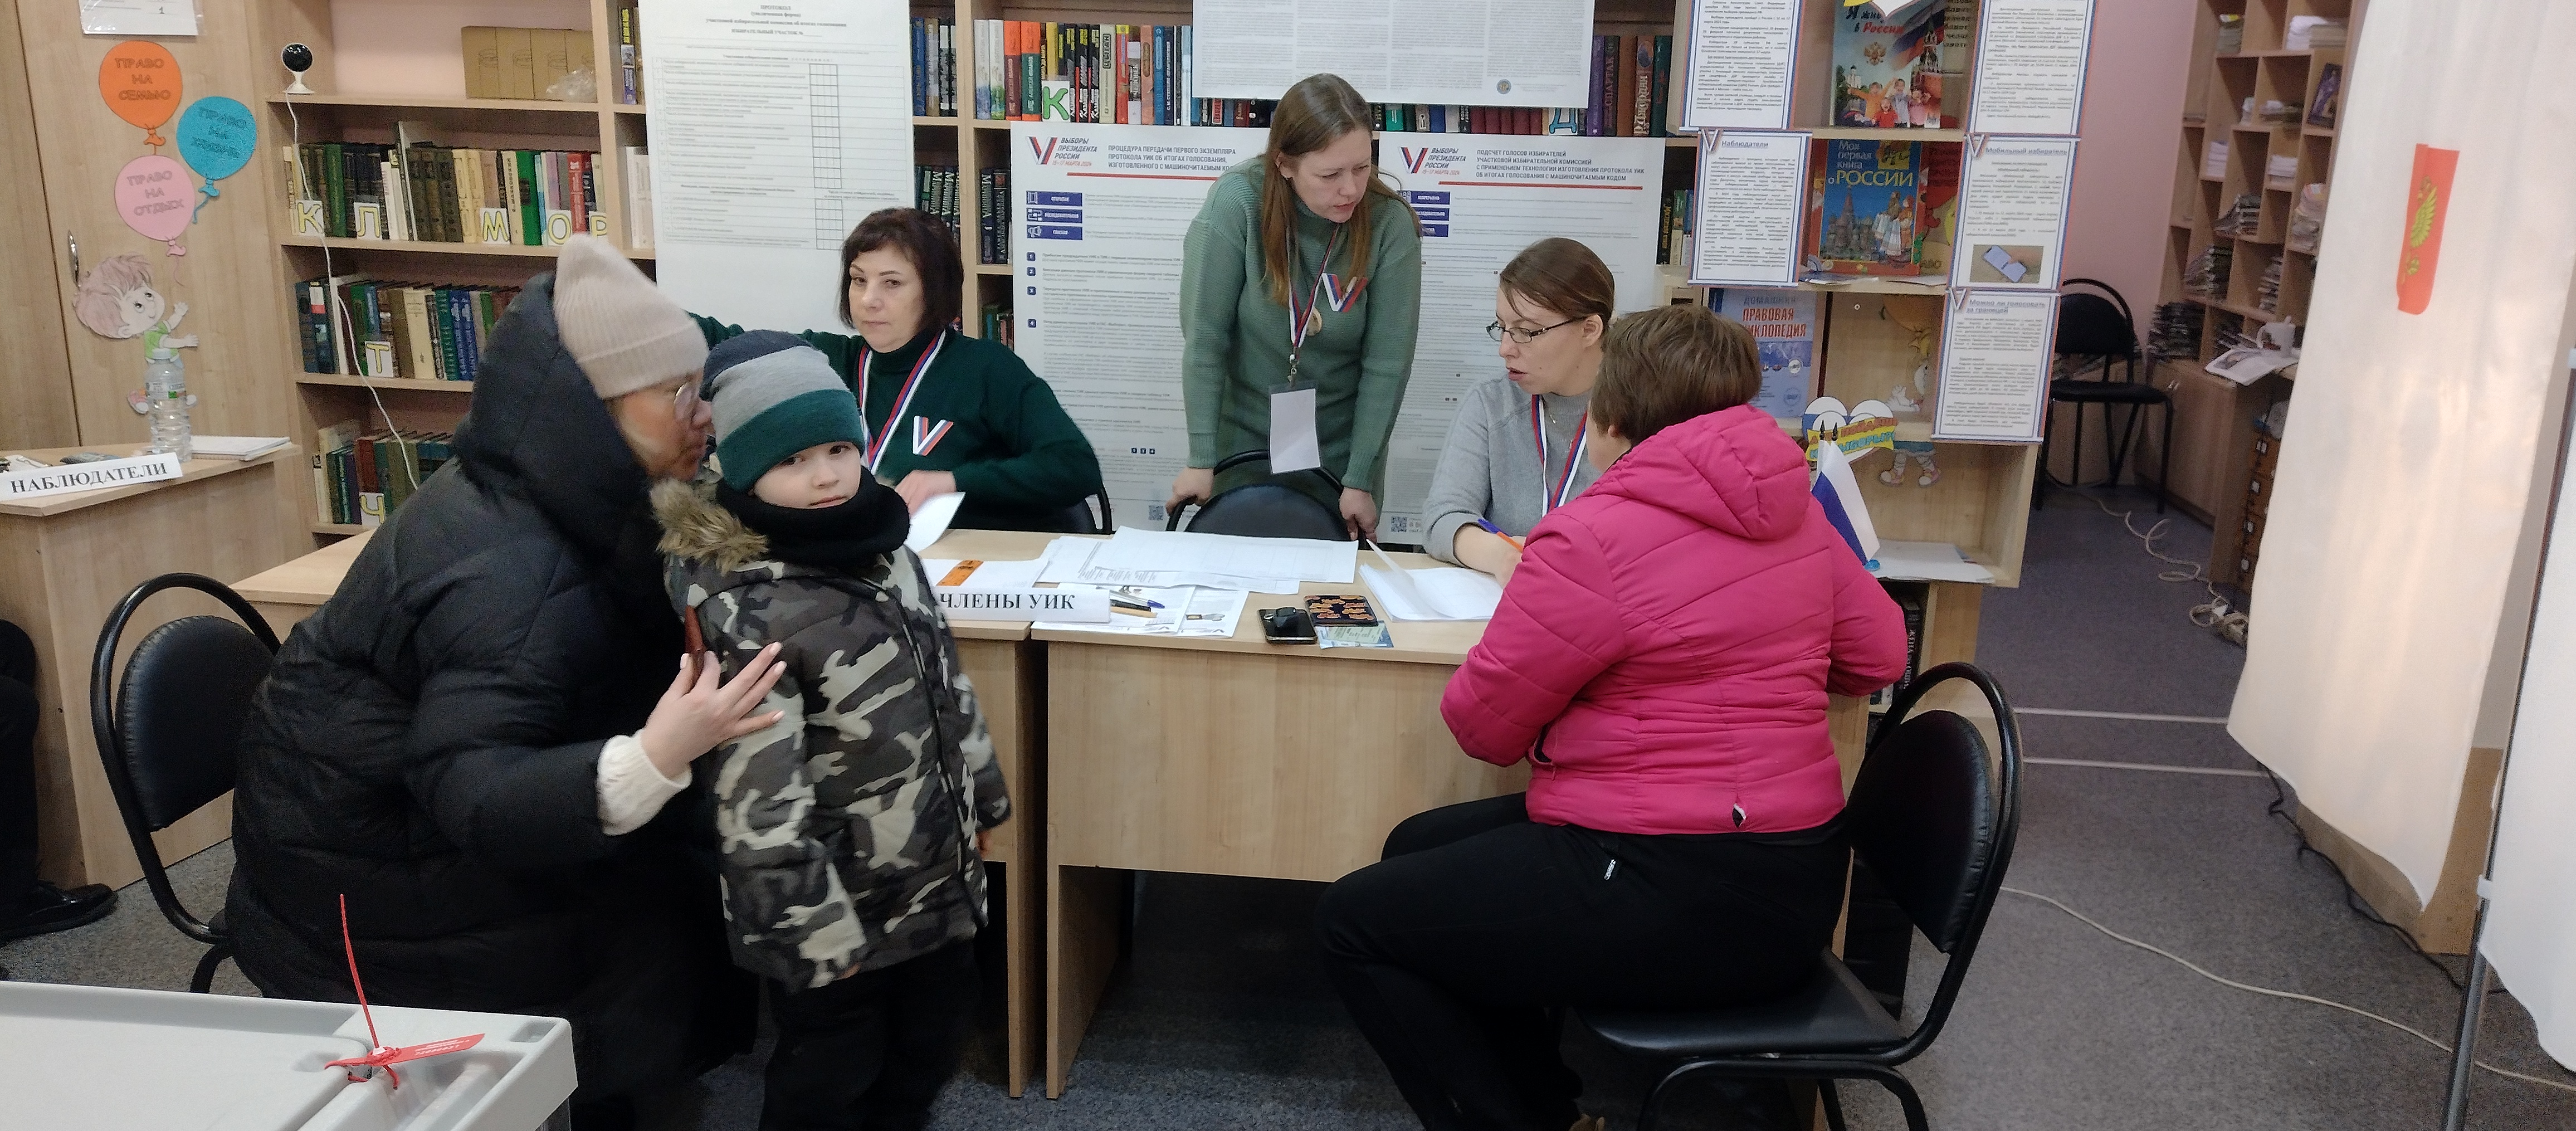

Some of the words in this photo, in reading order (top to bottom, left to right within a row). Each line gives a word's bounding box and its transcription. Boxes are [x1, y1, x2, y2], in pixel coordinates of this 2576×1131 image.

[159, 6, 165, 14] 1
[1863, 21, 1905, 35] России
[115, 58, 164, 69] ПРАВО
[132, 74, 152, 84] НА
[119, 90, 171, 101] СЕМЬЮ
[1043, 86, 1070, 120] К
[199, 108, 247, 129] ПРАВО
[1839, 141, 1860, 150] Моя
[1838, 152, 1872, 160] первая
[1837, 161, 1862, 169] книга
[127, 171, 172, 187] ПРАВО
[1837, 170, 1914, 187] РОССИИ
[145, 188, 164, 198] НА
[134, 199, 184, 216] ОТДЫХ
[298, 202, 324, 234] К
[357, 206, 381, 239] Л
[482, 211, 509, 242] М
[548, 214, 572, 245] О
[1743, 308, 1795, 321] ПРАВОВАЯ
[1749, 324, 1807, 339] ИКЛОПЕДИЯ
[367, 343, 391, 374] Т
[12, 463, 167, 494] НАБЛЮДАТЕЛИ
[359, 495, 385, 524] Ч
[939, 593, 1021, 609] ЧЛЕНЫ
[1029, 594, 1076, 610] УИК
